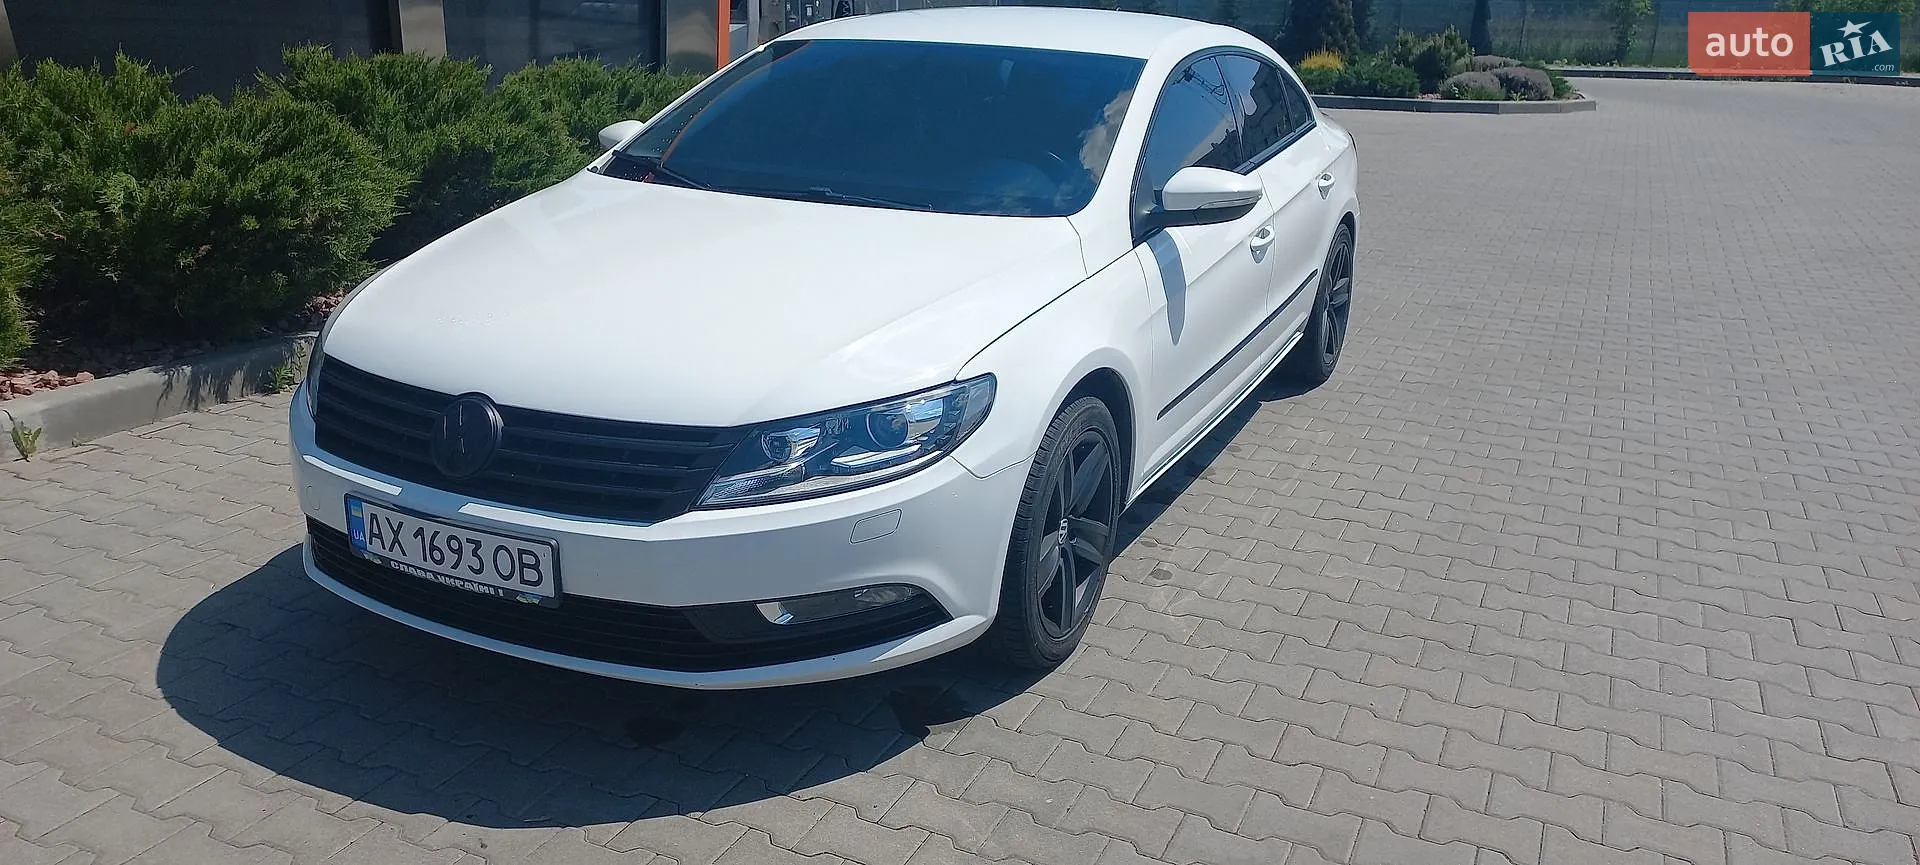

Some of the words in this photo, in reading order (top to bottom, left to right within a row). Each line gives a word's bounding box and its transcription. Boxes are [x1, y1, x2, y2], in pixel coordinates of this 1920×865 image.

[353, 530, 366, 542] UA
[368, 513, 407, 557] AX
[413, 526, 485, 575] 1693
[493, 544, 543, 587] OB
[390, 561, 435, 582] СЛАВА
